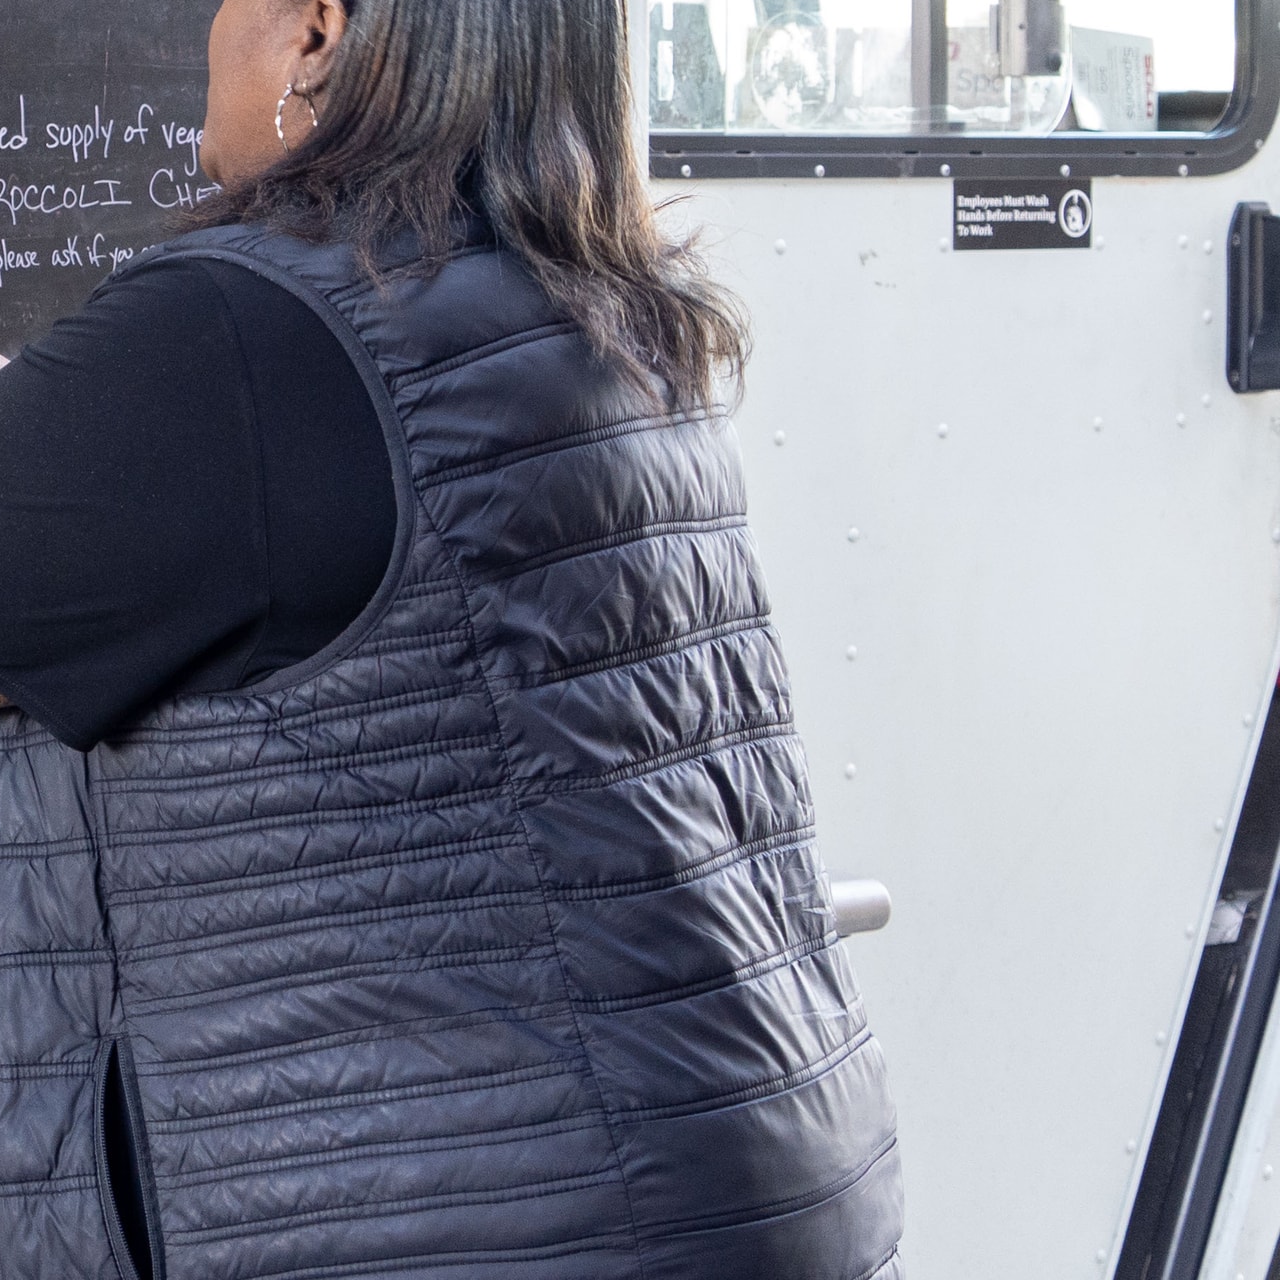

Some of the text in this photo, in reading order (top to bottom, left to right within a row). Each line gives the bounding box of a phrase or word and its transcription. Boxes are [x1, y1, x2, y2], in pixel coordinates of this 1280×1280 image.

[45, 104, 114, 163] supply
[124, 103, 153, 145] of
[957, 194, 1049, 210] Employees Must Wash
[957, 209, 1056, 224] Hands Before Returning
[957, 224, 993, 237] To Work
[51, 235, 82, 267] ask
[86, 232, 106, 268] if
